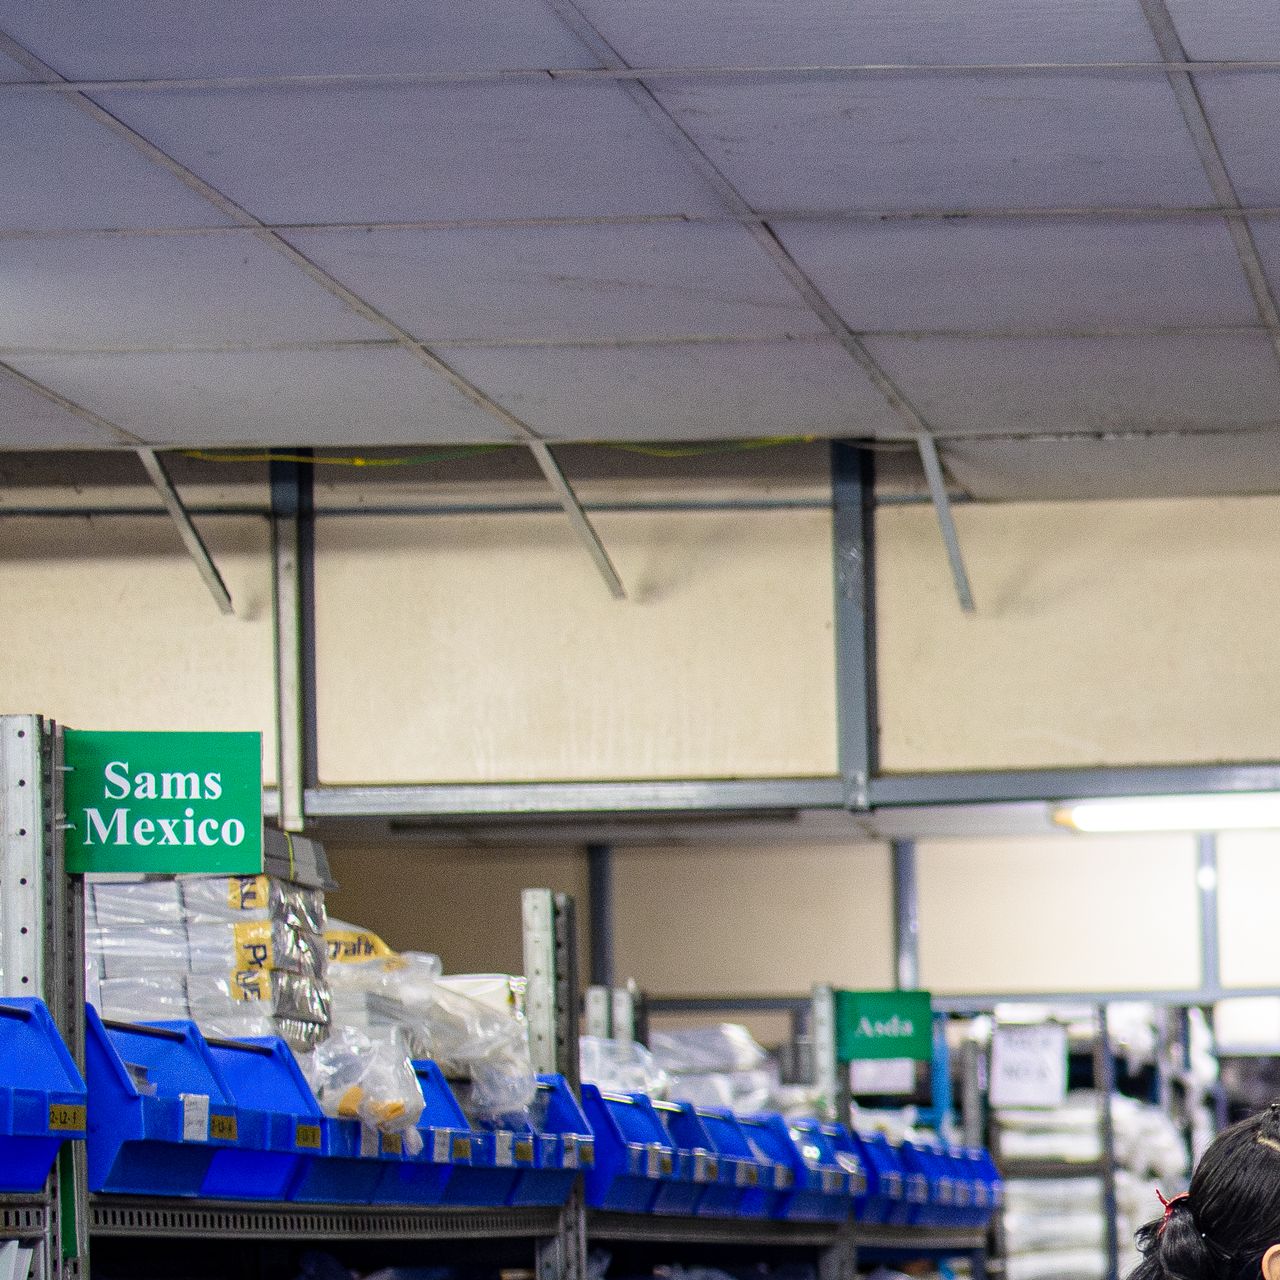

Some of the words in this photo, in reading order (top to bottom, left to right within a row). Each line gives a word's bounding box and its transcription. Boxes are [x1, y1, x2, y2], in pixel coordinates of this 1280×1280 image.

[104, 761, 222, 800] Sams
[83, 808, 245, 846] Mexico
[855, 1015, 914, 1037] Asda
